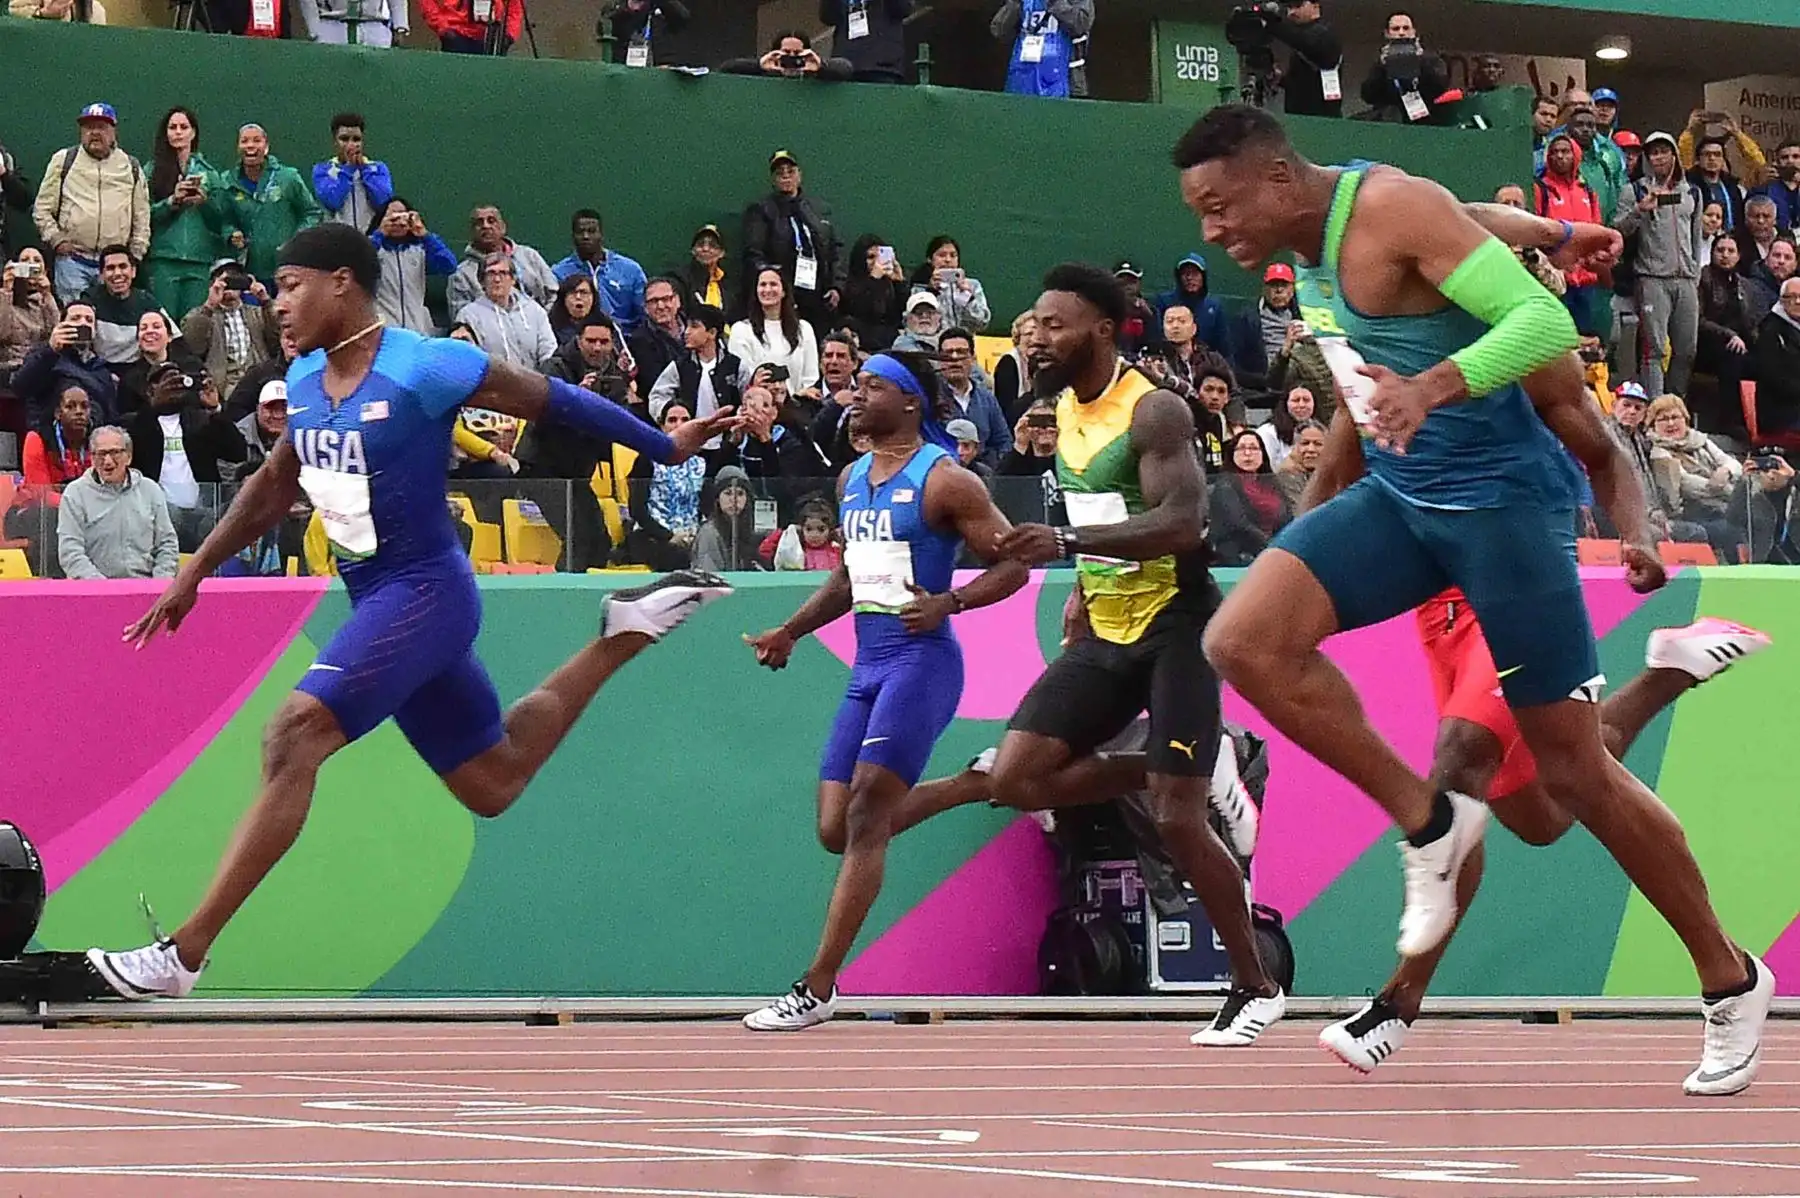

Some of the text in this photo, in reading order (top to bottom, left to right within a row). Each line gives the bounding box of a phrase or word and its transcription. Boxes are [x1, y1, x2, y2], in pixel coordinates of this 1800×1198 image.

[1176, 61, 1220, 82] 2019
[294, 428, 368, 475] USA
[843, 509, 894, 541] USA
